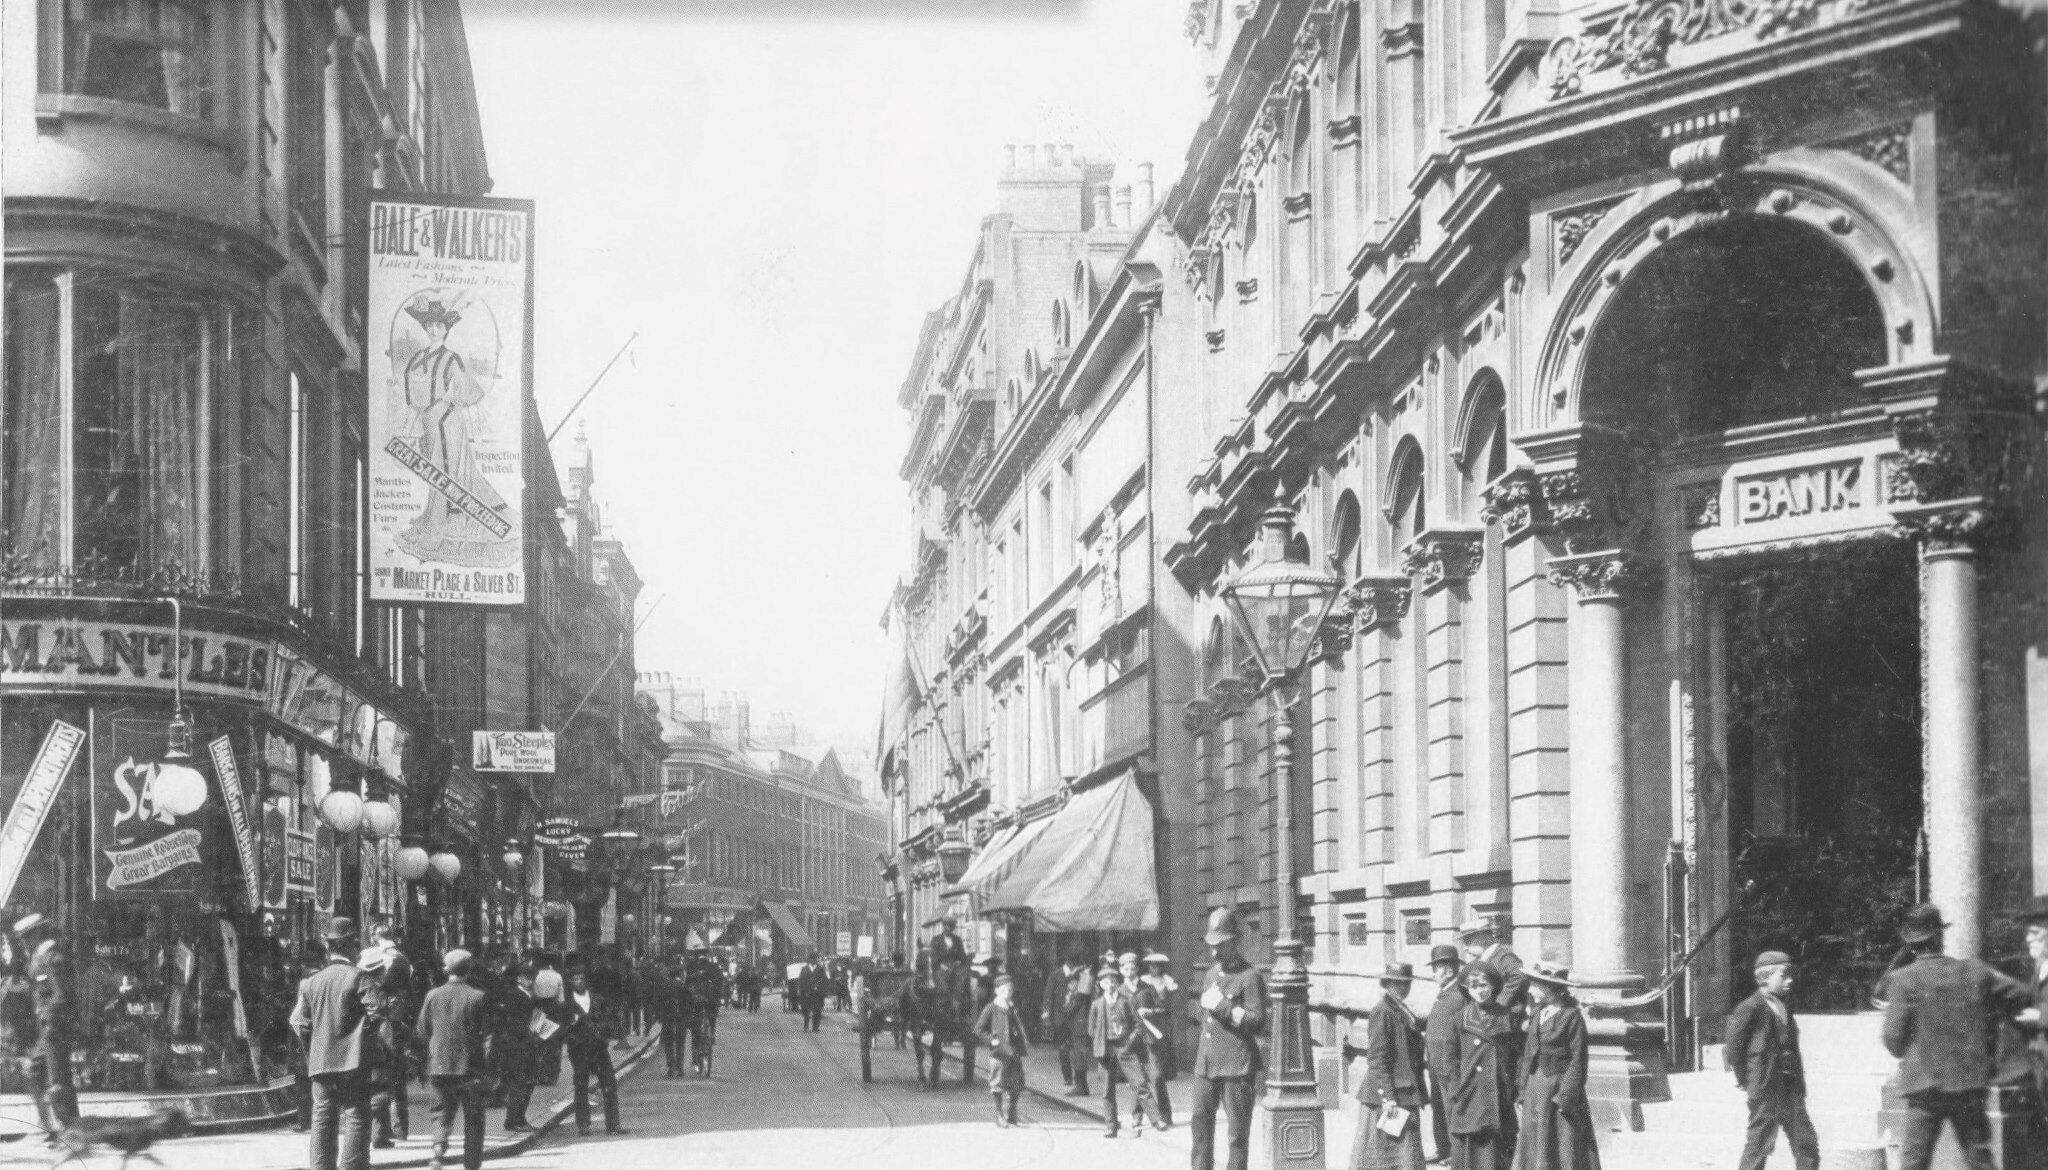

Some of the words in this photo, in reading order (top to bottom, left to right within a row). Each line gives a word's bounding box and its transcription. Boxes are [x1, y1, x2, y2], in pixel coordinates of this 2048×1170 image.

[373, 204, 421, 257] DALE
[421, 218, 431, 247] &
[475, 451, 520, 463] Inspection
[374, 476, 411, 486] Mantles
[386, 438, 419, 466] GREAT
[411, 458, 448, 489] SALE
[443, 480, 467, 502] NOW
[459, 494, 511, 537] PROCEEDING
[373, 489, 411, 498] Jackets
[1738, 465, 1860, 524] BANK
[373, 502, 421, 511] Costumes
[374, 514, 398, 523] Furs
[393, 567, 431, 590] MARKET
[433, 569, 461, 591] PLACE
[463, 570, 470, 591] &
[474, 571, 504, 593] SILVER
[424, 591, 472, 600] HULL
[1, 620, 270, 694] MANTLES
[491, 733, 512, 749] Two
[512, 733, 555, 750] Steeples
[20, 723, 79, 811] DEPARTMENTS
[212, 736, 240, 803] BARGAINS
[232, 808, 247, 833] ALL
[115, 846, 153, 866] Genuine
[121, 865, 150, 881] Great
[150, 847, 194, 875] Bargains
[290, 859, 311, 880] SALE
